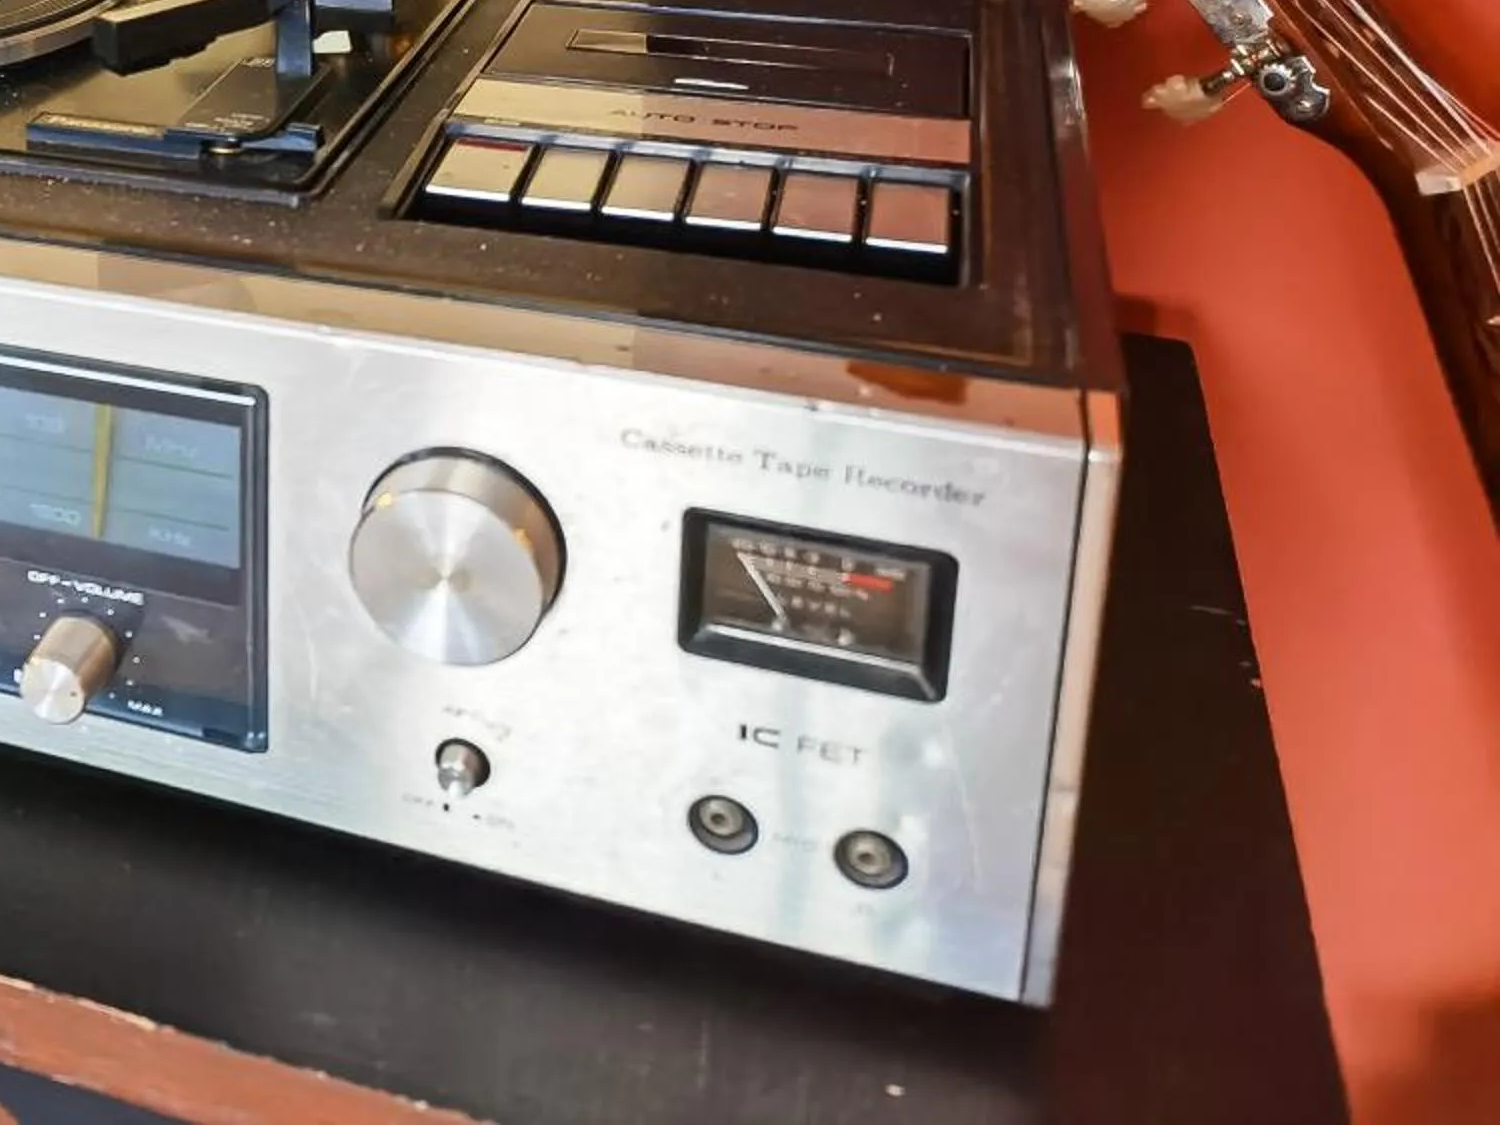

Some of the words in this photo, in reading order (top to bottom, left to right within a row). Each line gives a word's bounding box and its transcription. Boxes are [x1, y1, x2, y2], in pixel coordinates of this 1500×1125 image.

[609, 108, 696, 124] AUTO
[712, 117, 800, 132] STOP
[619, 426, 744, 464] Cassette
[753, 447, 832, 480] Tape
[843, 463, 987, 508] Recorder
[738, 723, 781, 750] IC
[796, 734, 866, 765] FET
